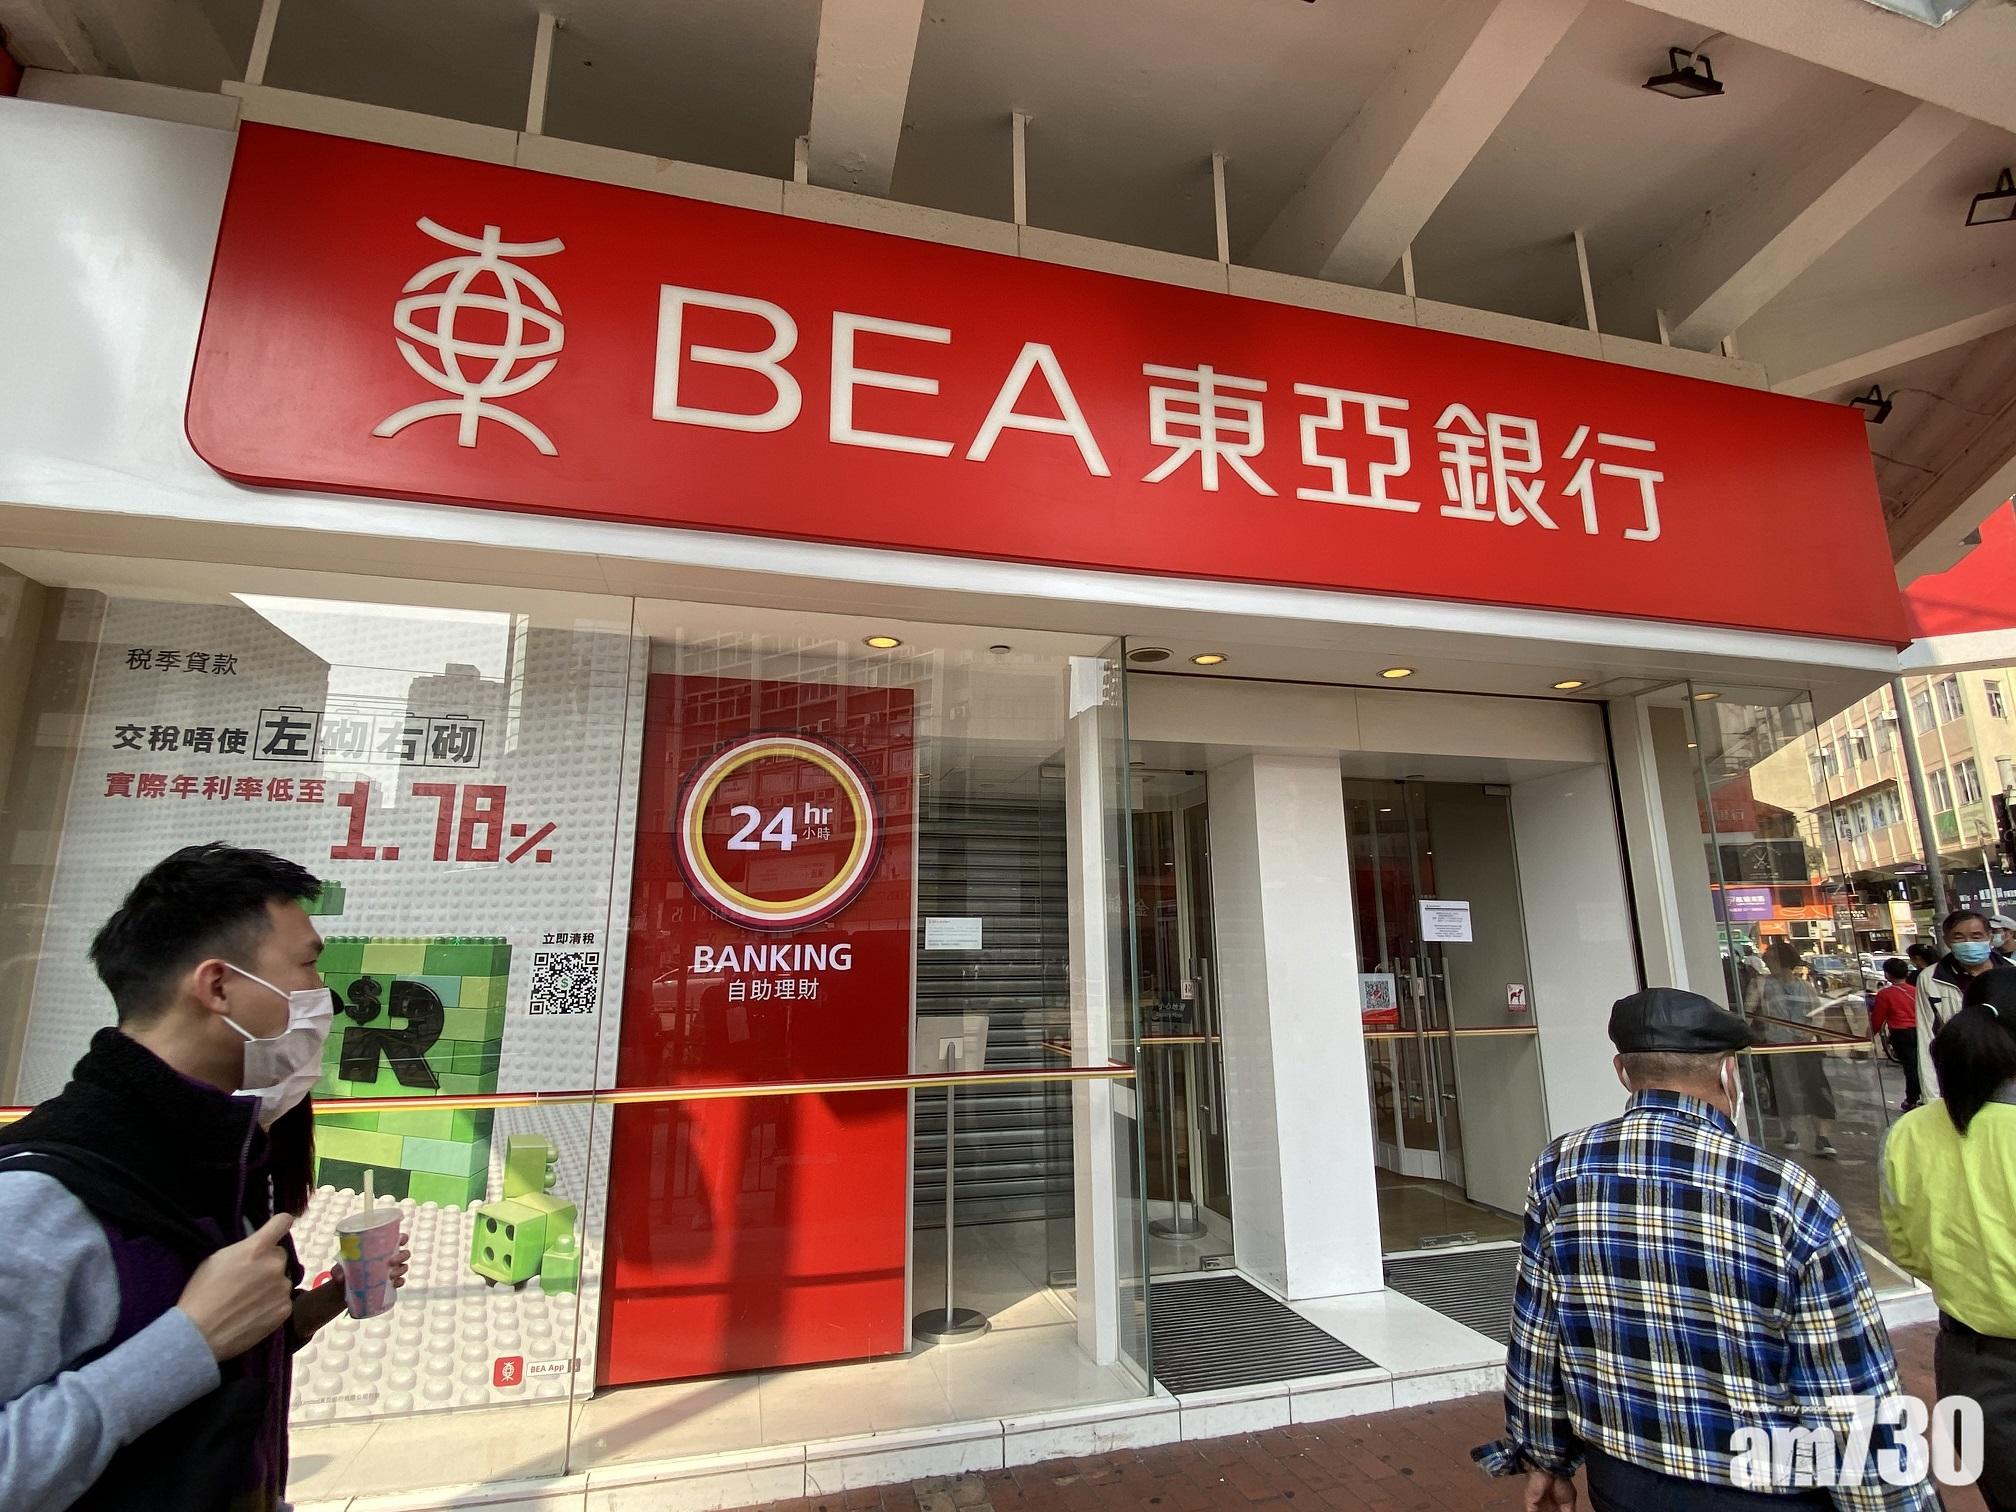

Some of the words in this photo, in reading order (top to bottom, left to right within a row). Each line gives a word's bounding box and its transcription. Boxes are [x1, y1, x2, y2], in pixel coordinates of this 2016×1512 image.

[651, 283, 1111, 478] BEA
[1141, 363, 1664, 542] 東亞銀行
[103, 772, 327, 804] 實際年利率低至
[329, 781, 557, 864] 1.78%
[727, 805, 798, 851] 24
[804, 802, 833, 825] hr
[802, 826, 831, 841] 小時
[693, 943, 853, 974] BANKING
[728, 977, 820, 1002] 自助理財
[530, 1365, 547, 1374] BEA
[548, 1364, 565, 1373] App
